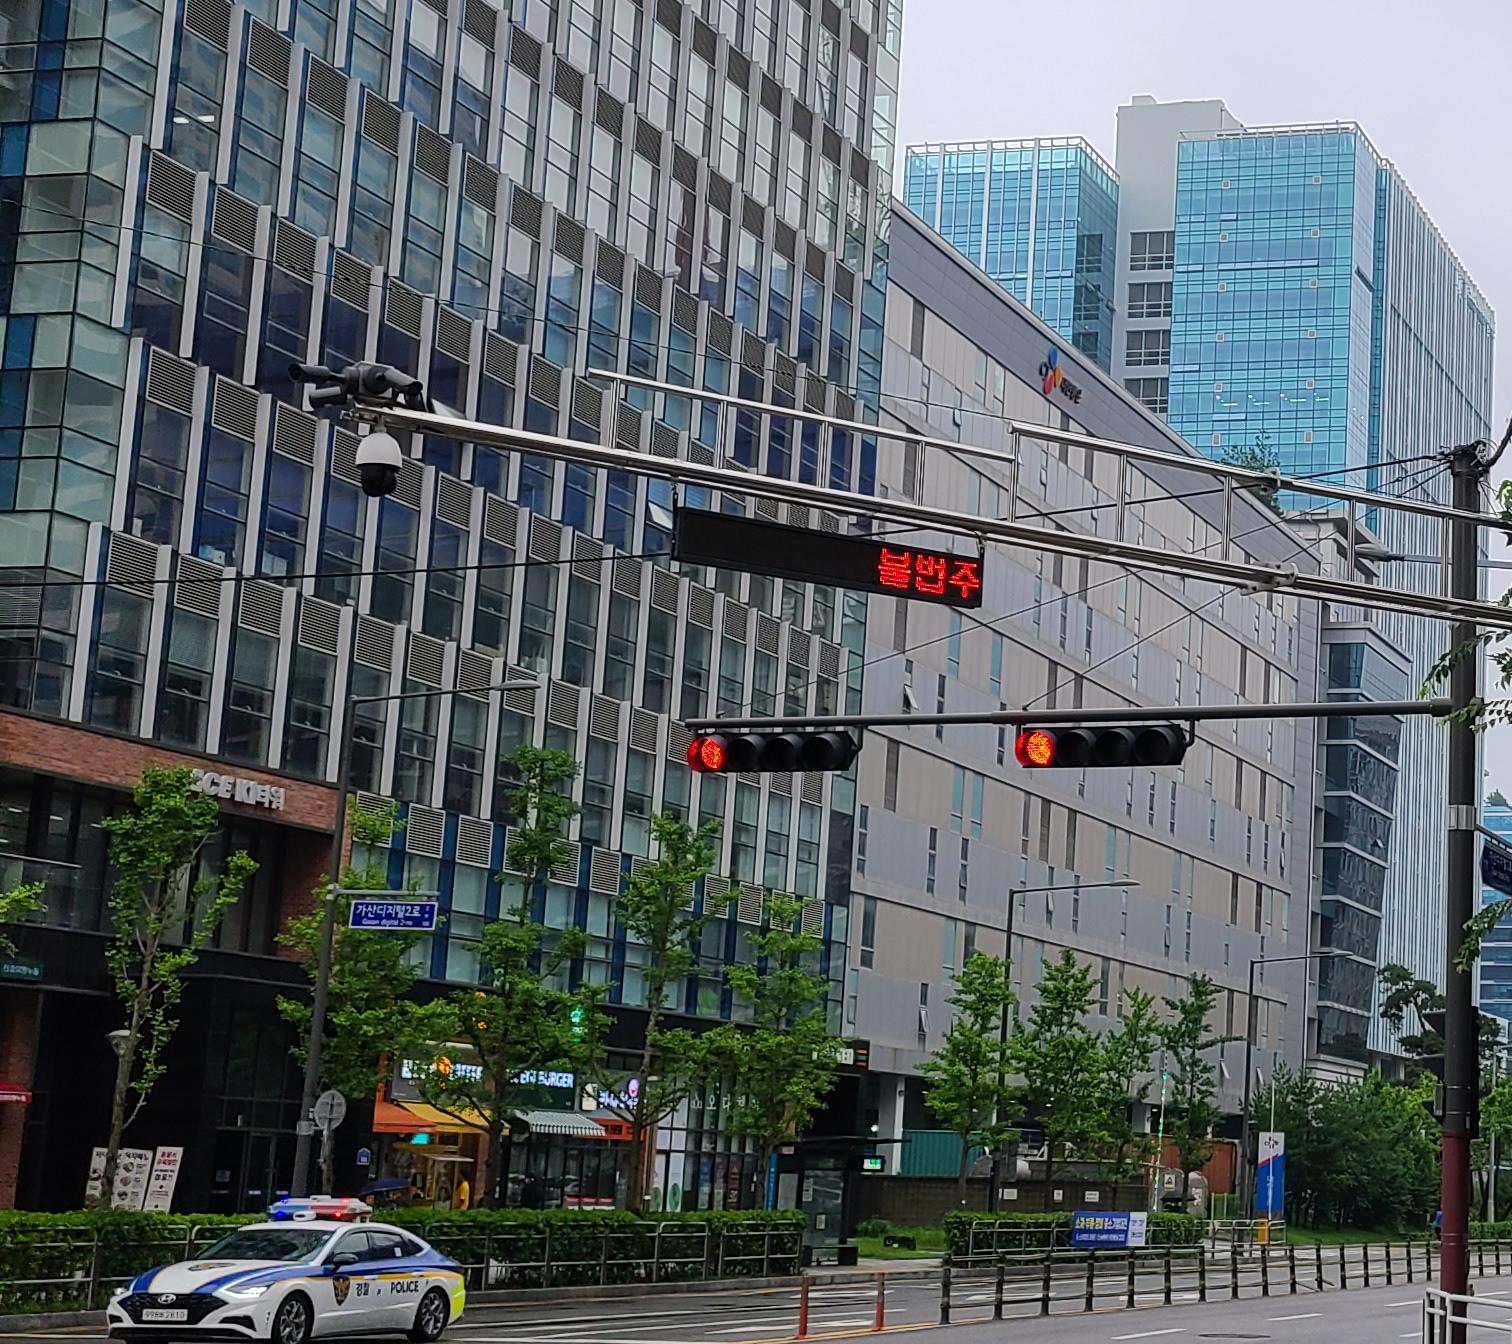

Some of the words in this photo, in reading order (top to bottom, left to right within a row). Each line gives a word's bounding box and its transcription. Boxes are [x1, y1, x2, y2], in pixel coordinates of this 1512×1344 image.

[878, 548, 980, 598] 불법주
[355, 904, 421, 918] 가산디지털2로
[356, 1282, 370, 1297] 경찰
[390, 1280, 419, 1295] POLICE
